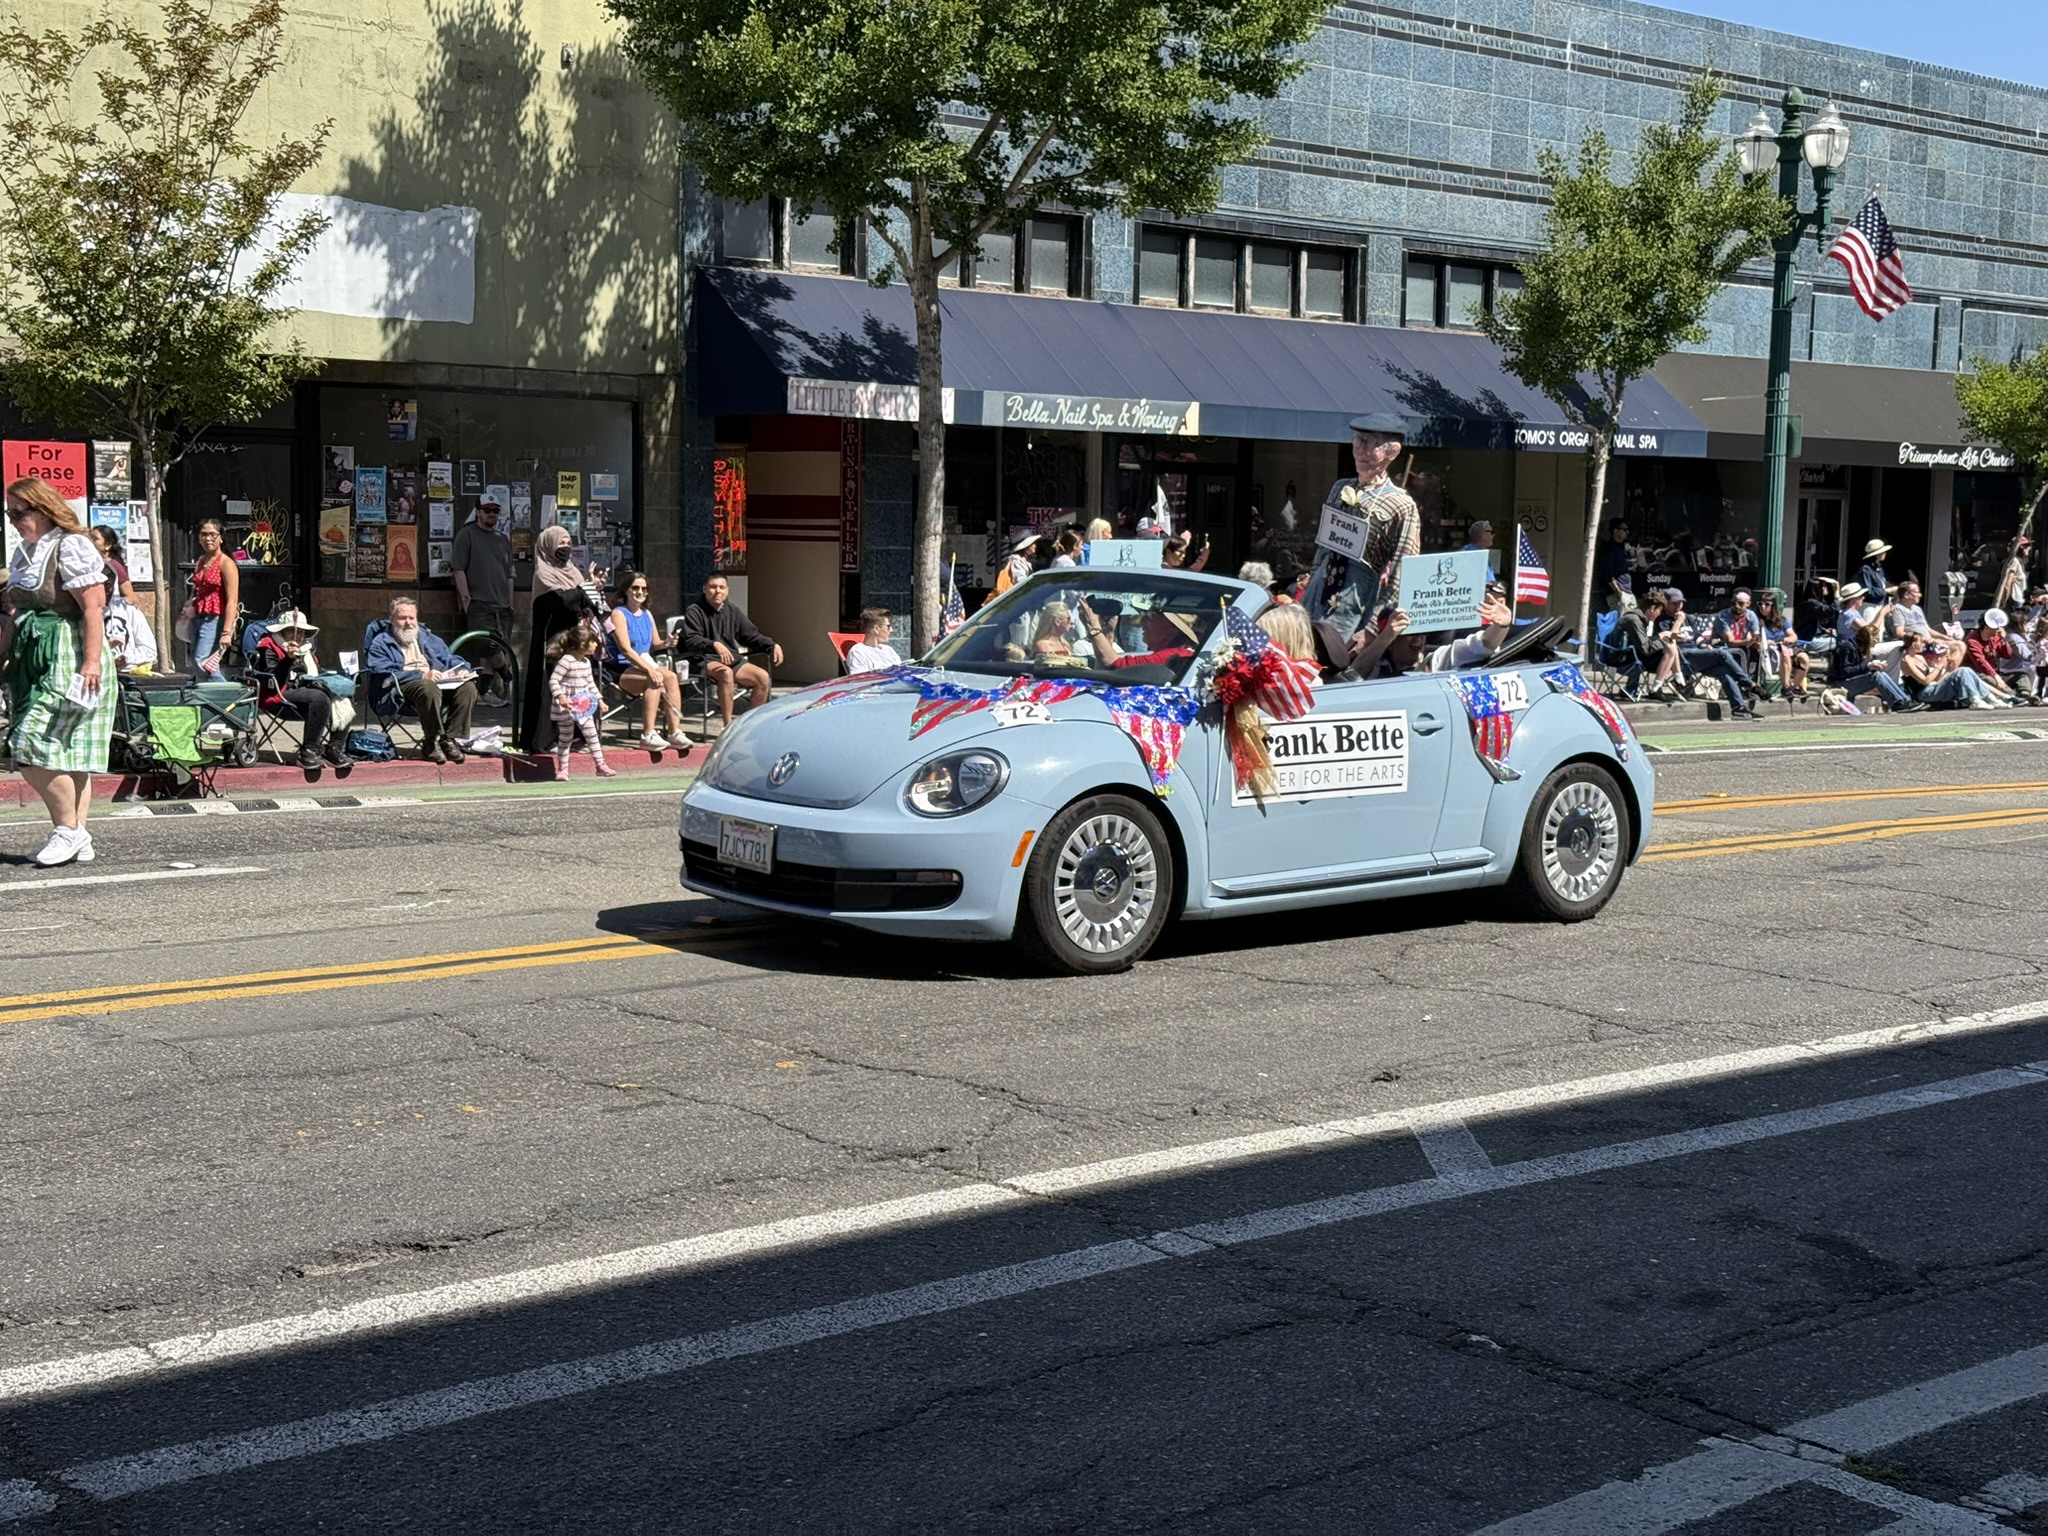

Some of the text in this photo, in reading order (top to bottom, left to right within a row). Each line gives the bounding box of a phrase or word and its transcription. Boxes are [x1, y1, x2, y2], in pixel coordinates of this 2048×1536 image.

[795, 384, 846, 414] LITTLE
[1006, 395, 1051, 424] Bella
[1050, 397, 1087, 427] Nail
[1088, 400, 1115, 430] Spa
[1118, 401, 1130, 428] &
[1514, 428, 1556, 446] TOMO'S
[1612, 433, 1636, 449] NAIL
[1638, 434, 1657, 449] SPA
[28, 444, 63, 461] For
[1898, 441, 2015, 471] Triumphant Life Church
[16, 463, 75, 480] Lease
[1330, 513, 1359, 535] Frank
[1328, 531, 1354, 550] Bette
[1646, 572, 1672, 585] Sunday
[1699, 572, 1737, 585] Wednesday
[1413, 586, 1472, 600] Frank Bette
[1709, 585, 1726, 597] 7 pm
[1408, 610, 1427, 618] OUTH
[1427, 607, 1450, 616] SHORE
[1501, 680, 1522, 702] 72
[1003, 705, 1039, 720] 72
[1262, 724, 1404, 758] rank Bette
[1303, 769, 1331, 787] FOR
[1337, 766, 1364, 783] THE
[1369, 763, 1405, 780] ARTS
[722, 833, 768, 865] 7JCY781
